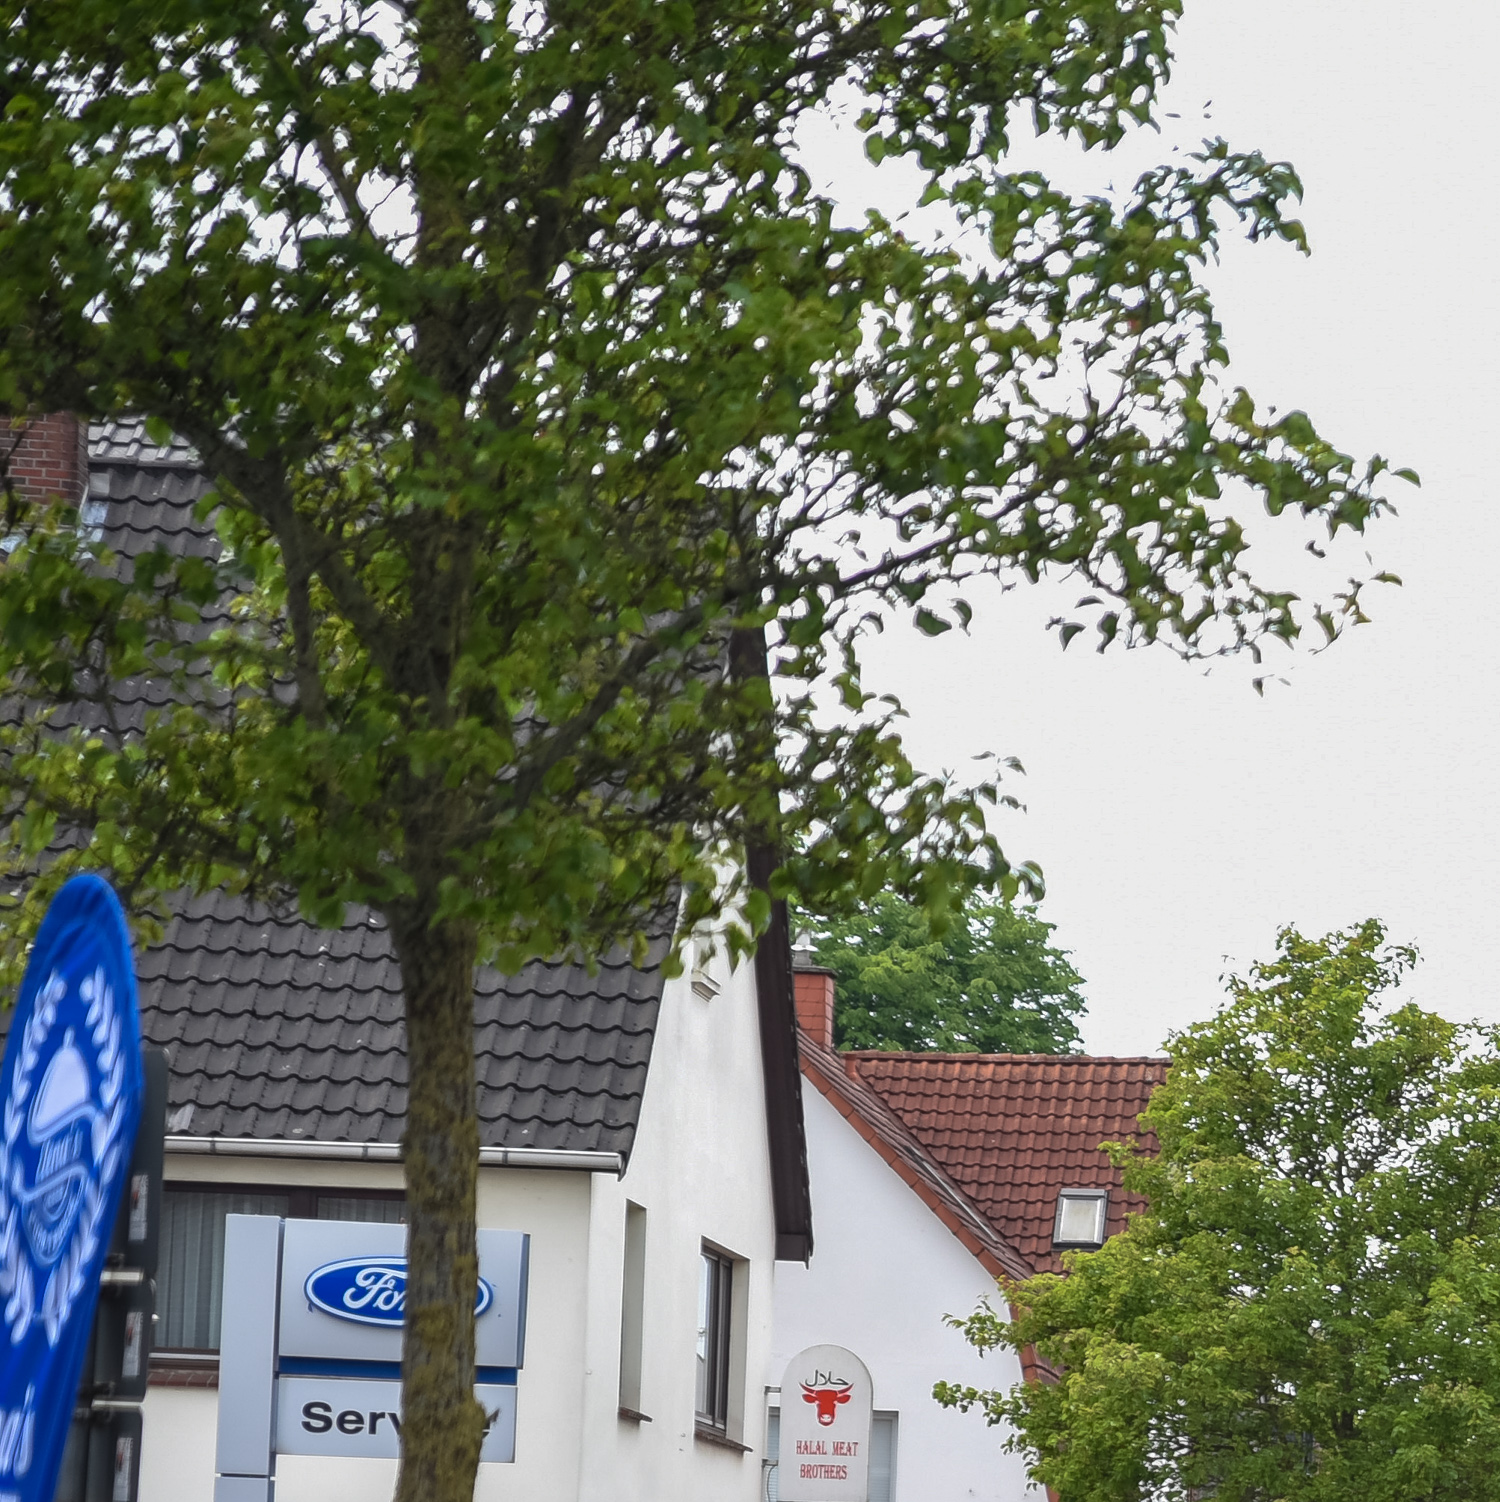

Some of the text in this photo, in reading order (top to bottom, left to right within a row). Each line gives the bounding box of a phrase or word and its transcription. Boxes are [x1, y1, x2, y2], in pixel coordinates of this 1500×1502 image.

[804, 1369, 849, 1387] حلال
[796, 1440, 859, 1456] HALAL MEAT
[799, 1463, 848, 1480] BROTHERS
